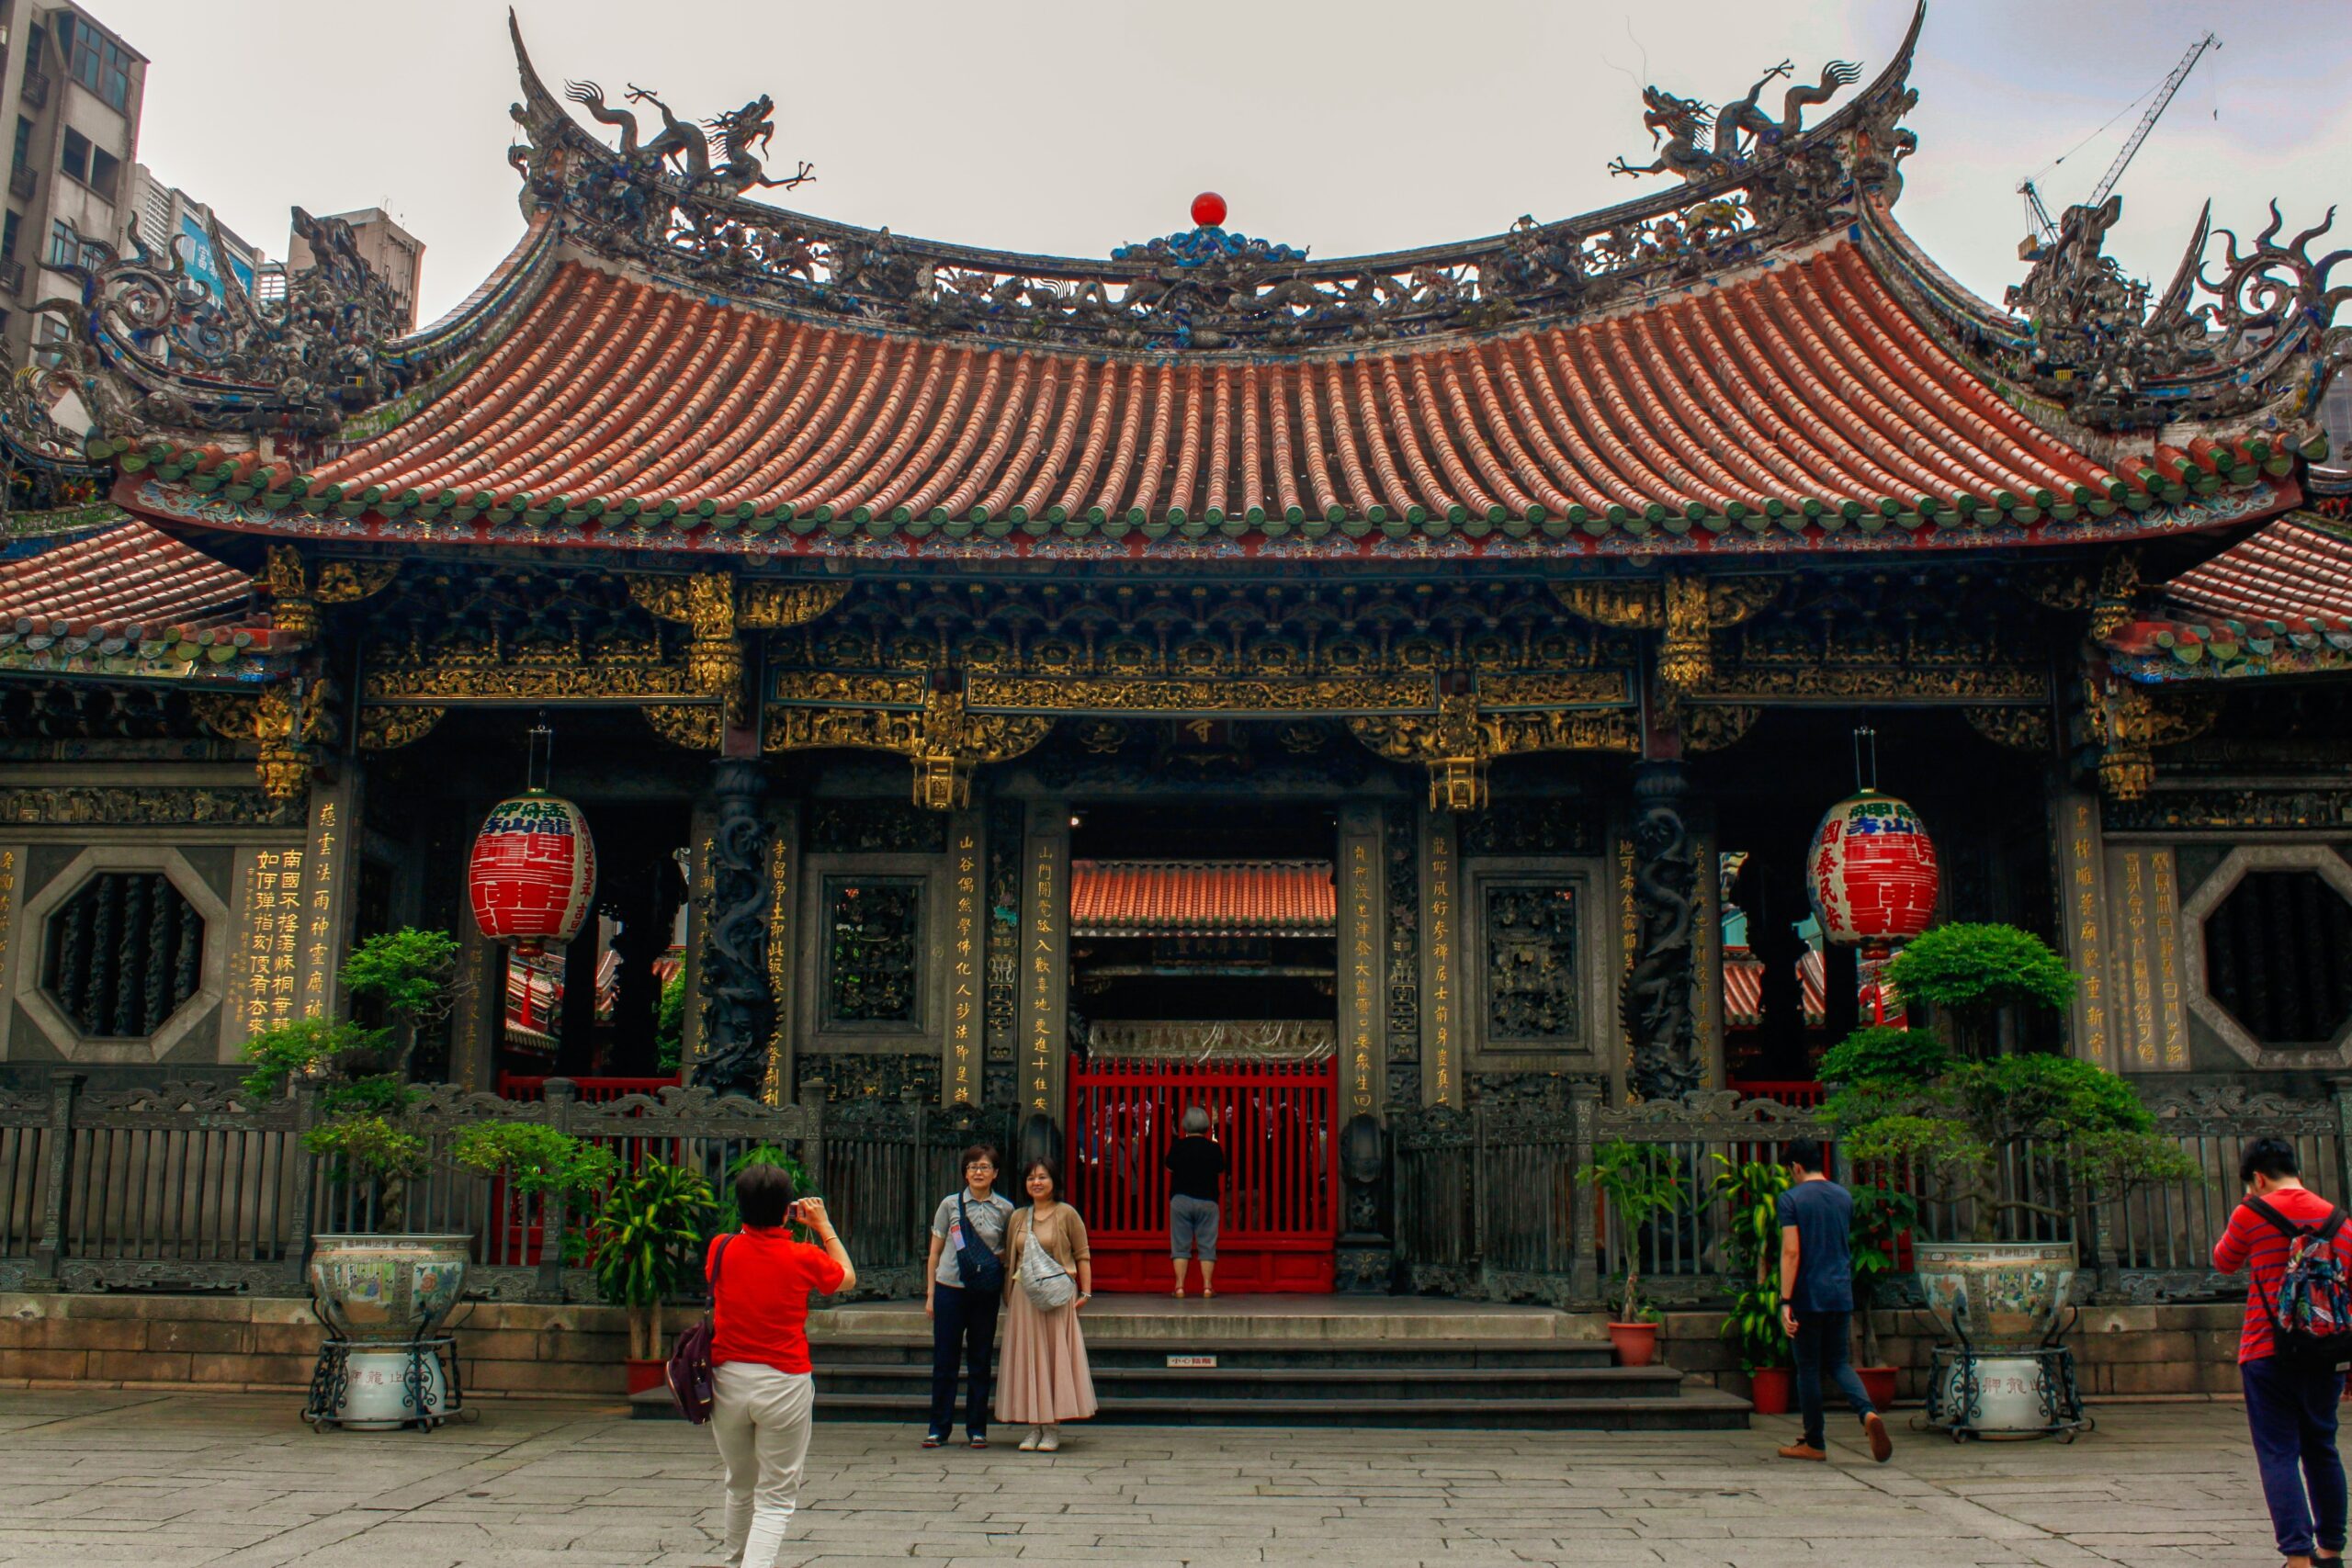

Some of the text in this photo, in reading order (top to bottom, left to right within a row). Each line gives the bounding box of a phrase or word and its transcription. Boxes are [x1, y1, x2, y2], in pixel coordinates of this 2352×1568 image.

[481, 817, 575, 836] 龍山寺
[1815, 818, 1845, 932] 國泰民安
[304, 803, 337, 1073] 慈雲法雨神靈廣被
